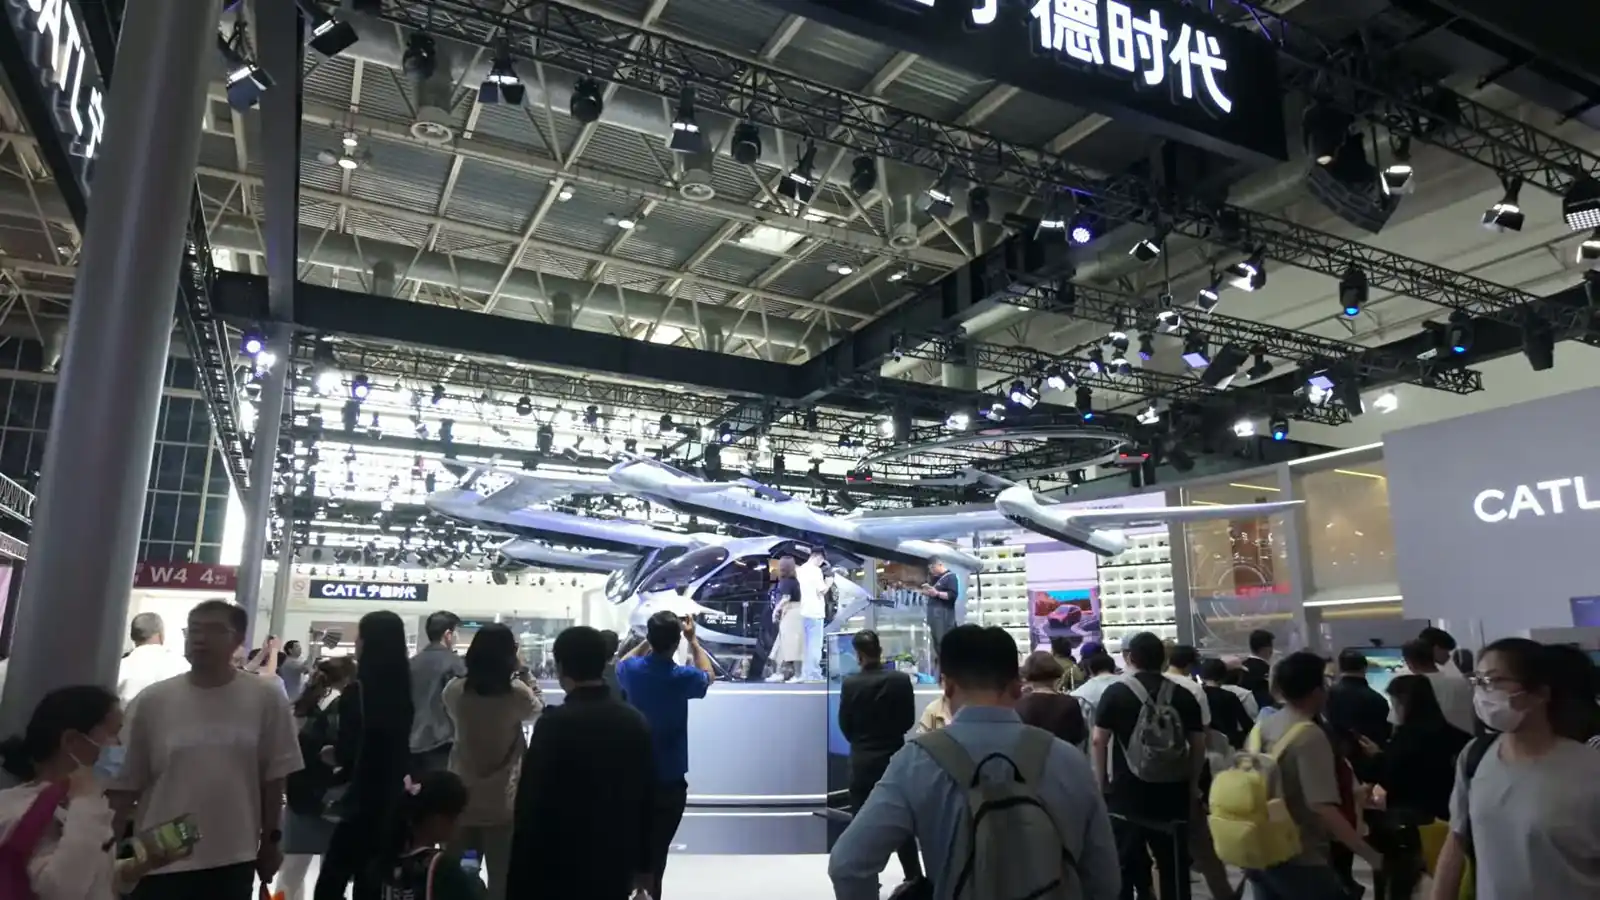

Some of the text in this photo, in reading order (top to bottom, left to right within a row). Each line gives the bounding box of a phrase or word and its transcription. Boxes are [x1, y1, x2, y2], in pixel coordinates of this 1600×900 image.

[27, 0, 85, 136] ATL
[971, 0, 1232, 113] 德时代
[1473, 475, 1600, 522] CATL
[150, 566, 188, 584] W4
[321, 583, 366, 597] CATL
